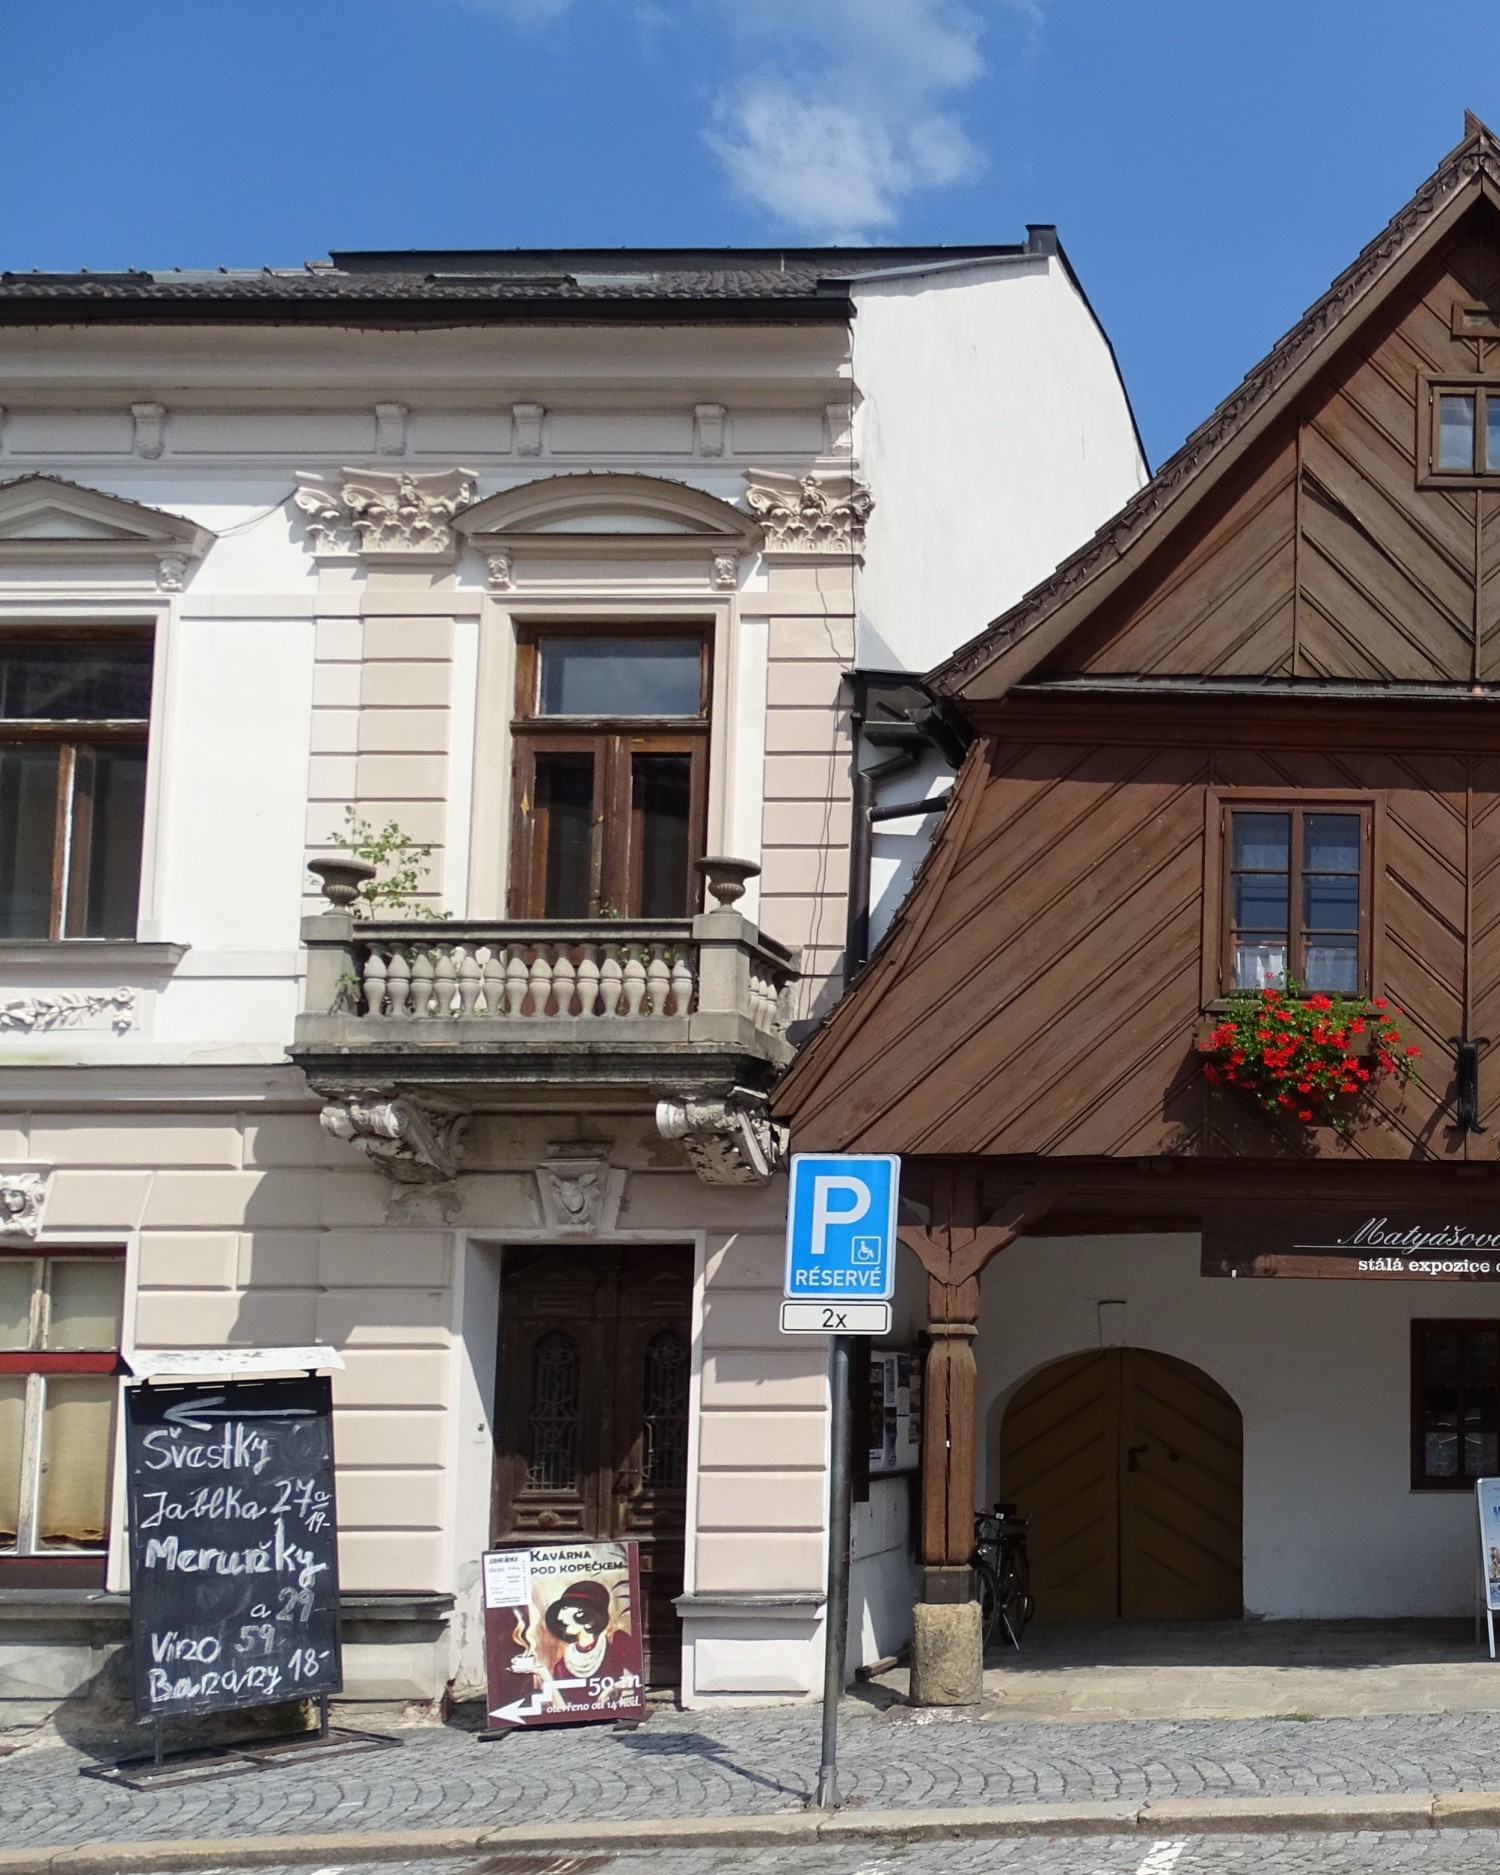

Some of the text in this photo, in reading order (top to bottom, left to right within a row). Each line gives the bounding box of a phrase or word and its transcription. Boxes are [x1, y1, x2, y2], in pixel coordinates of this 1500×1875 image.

[811, 1175, 871, 1255] P
[1358, 1257, 1403, 1272] stálá
[1408, 1259, 1490, 1275] expozice
[795, 1266, 881, 1287] RÉSERVÉ
[822, 1308, 848, 1328] 2x
[142, 1421, 272, 1476] Švestky
[140, 1486, 267, 1529] Jablka
[270, 1478, 316, 1518] 27
[530, 1550, 592, 1562] KAVÁRNA
[530, 1565, 556, 1575] POD
[560, 1560, 624, 1573] KOPEČKEM
[588, 1676, 615, 1696] 50
[546, 1701, 590, 1713] otevřeno
[591, 1696, 605, 1710] od
[607, 1700, 617, 1711] 14
